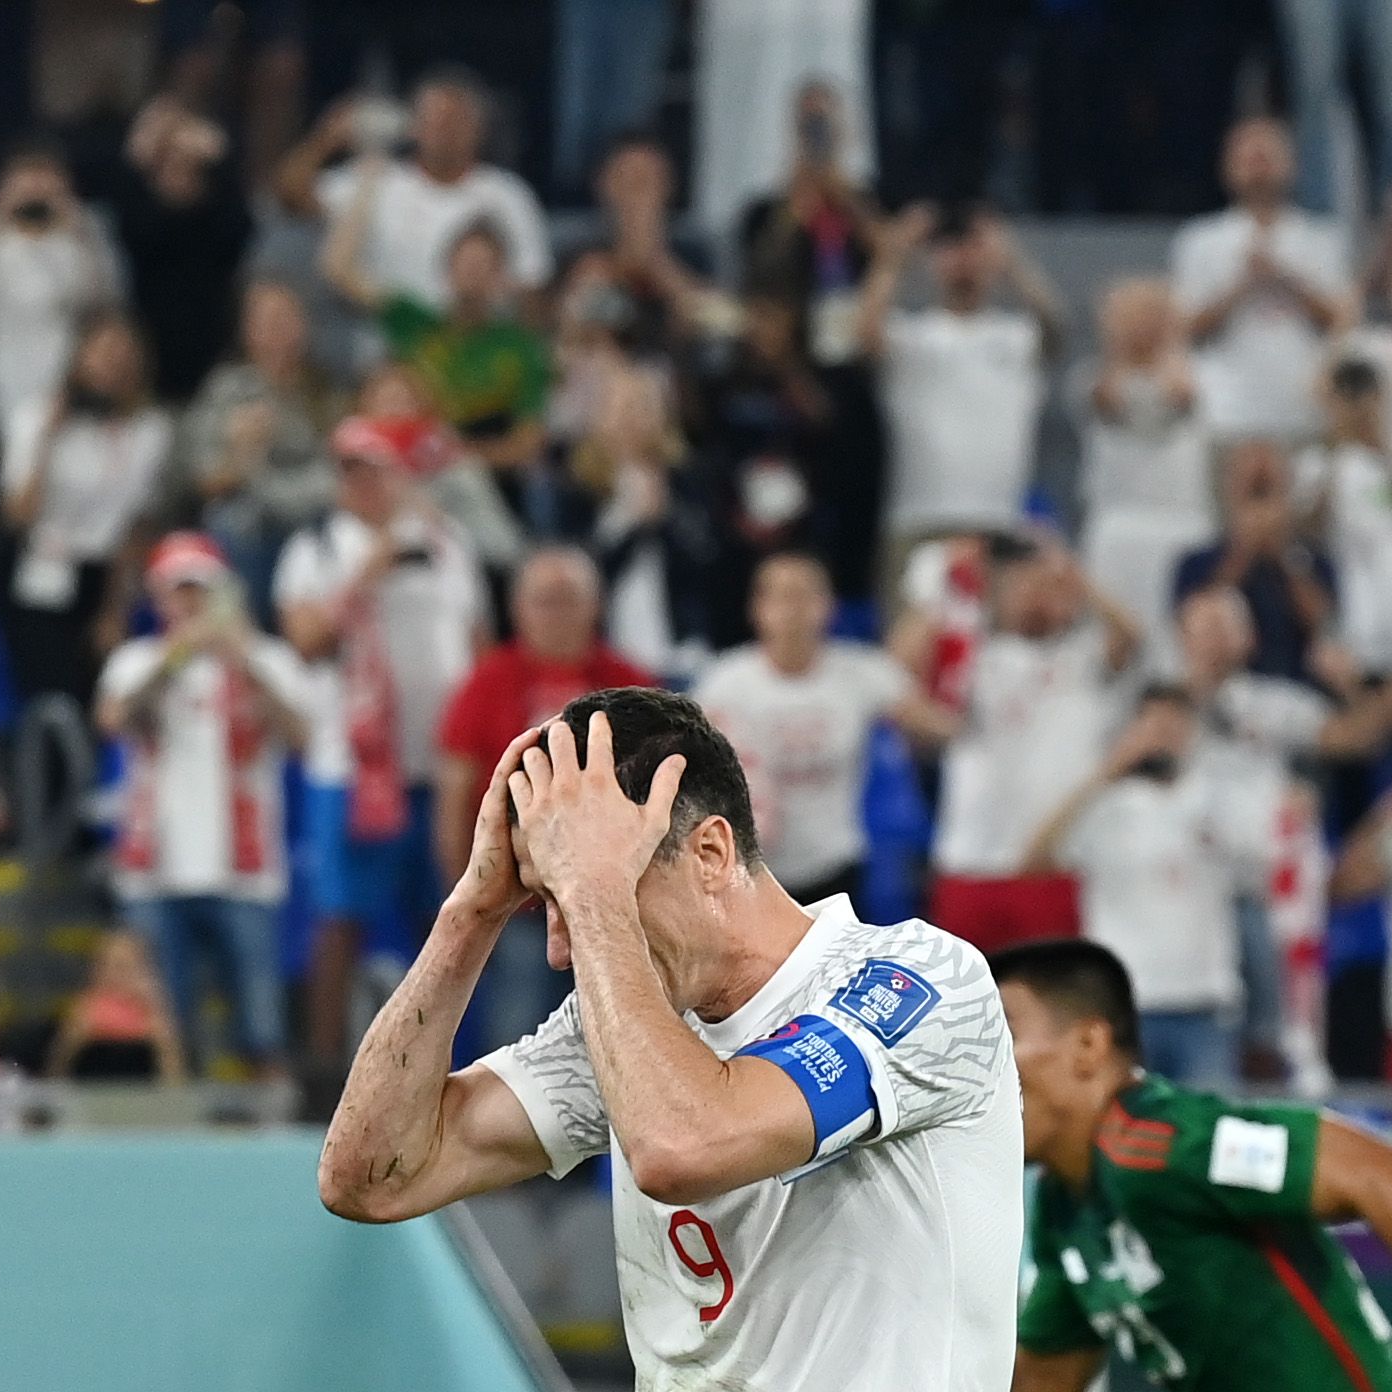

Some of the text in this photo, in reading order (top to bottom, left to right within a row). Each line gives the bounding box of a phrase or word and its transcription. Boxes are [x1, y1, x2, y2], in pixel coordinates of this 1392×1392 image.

[792, 1039, 841, 1084] UNITES
[801, 1057, 833, 1093] World
[803, 1031, 848, 1076] FOOTBALL
[668, 1209, 734, 1322] 9
